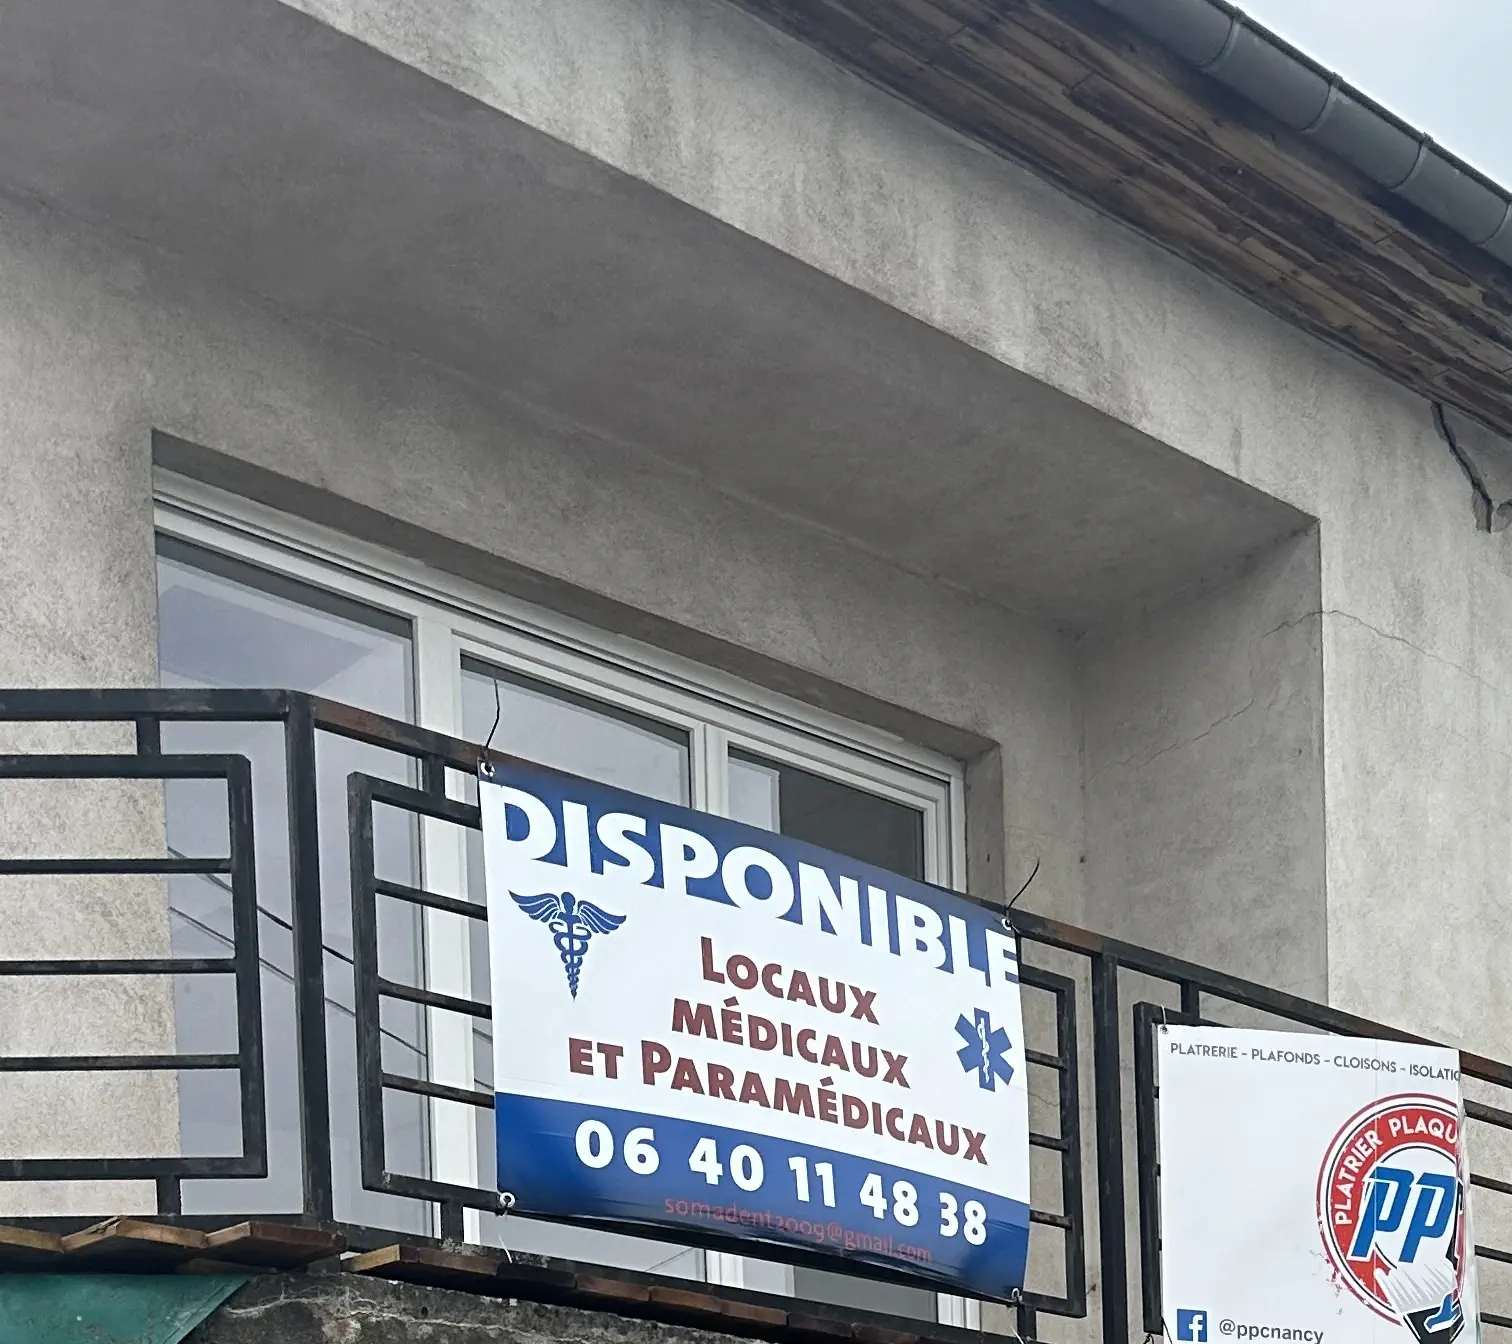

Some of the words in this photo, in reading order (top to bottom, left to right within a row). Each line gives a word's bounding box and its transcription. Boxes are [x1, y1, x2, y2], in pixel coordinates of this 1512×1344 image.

[480, 782, 1019, 987] DISPONIBLE
[701, 936, 880, 1025] LOCAUX
[671, 996, 911, 1089] MÉDICAUX
[1170, 1043, 1238, 1059] PLATRERIE
[1252, 1048, 1320, 1065] PLAFONDS
[1334, 1055, 1396, 1073] CLOISONS
[568, 1038, 624, 1079] ET
[641, 1039, 989, 1166] PARAMÉDICAUX
[575, 1119, 660, 1175] 06
[688, 1137, 764, 1192] 40
[788, 1156, 836, 1208] 11
[859, 1173, 919, 1227] 48
[939, 1192, 987, 1246] 38
[1335, 1129, 1383, 1225] PLATRIER
